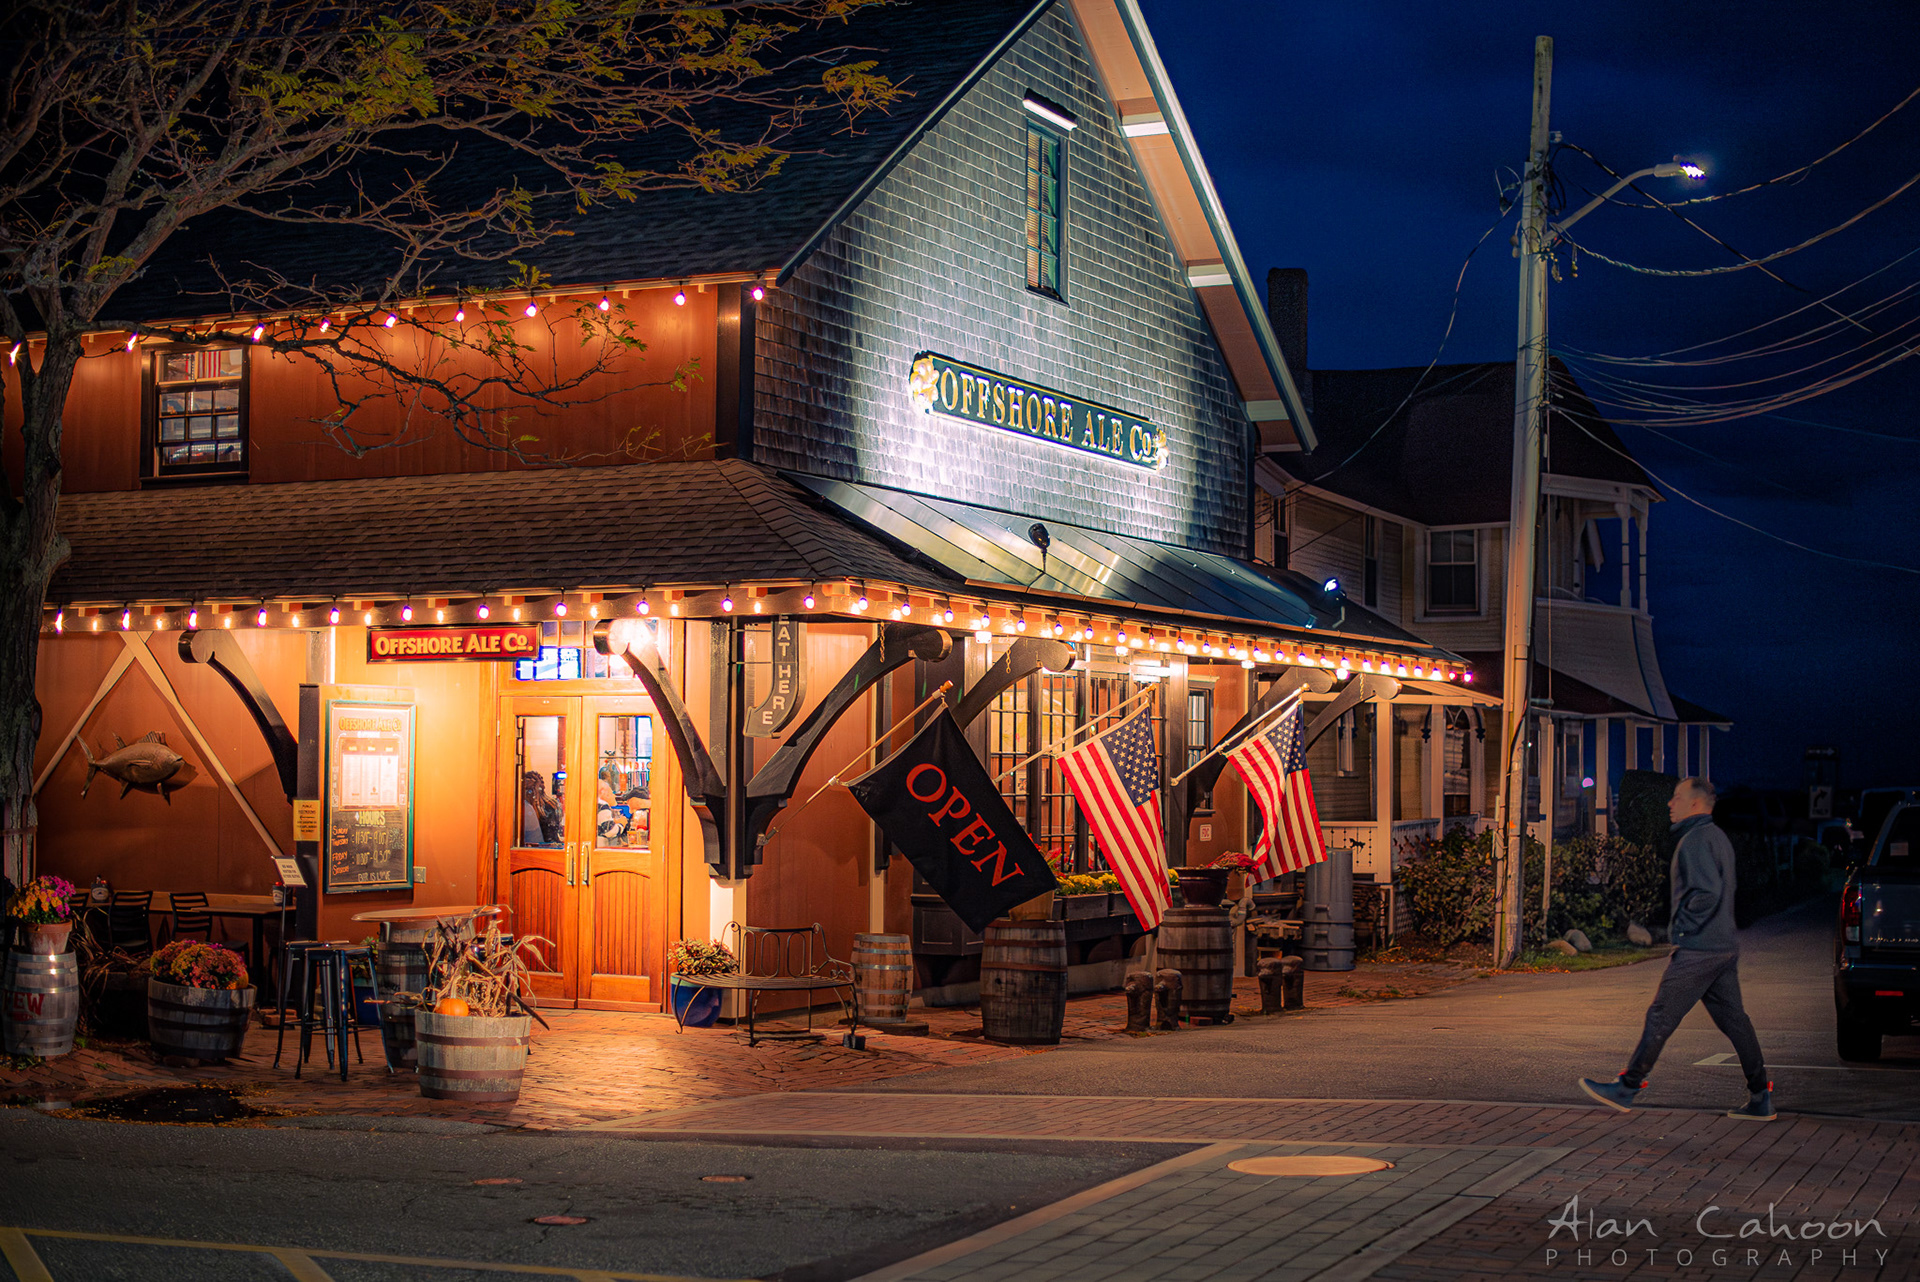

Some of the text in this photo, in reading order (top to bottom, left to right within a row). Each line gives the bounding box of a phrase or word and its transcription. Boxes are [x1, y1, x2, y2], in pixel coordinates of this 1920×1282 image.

[941, 366, 1074, 443] OFFSHORE
[1081, 410, 1123, 455] ALE
[375, 635, 464, 656] OFFSHORE
[465, 633, 501, 653] ALE
[762, 615, 792, 725] EAT HERE
[339, 717, 377, 731] OFFSHORE
[378, 717, 391, 731] ALE
[359, 810, 386, 825] HOURS
[905, 763, 1025, 887] OPEN
